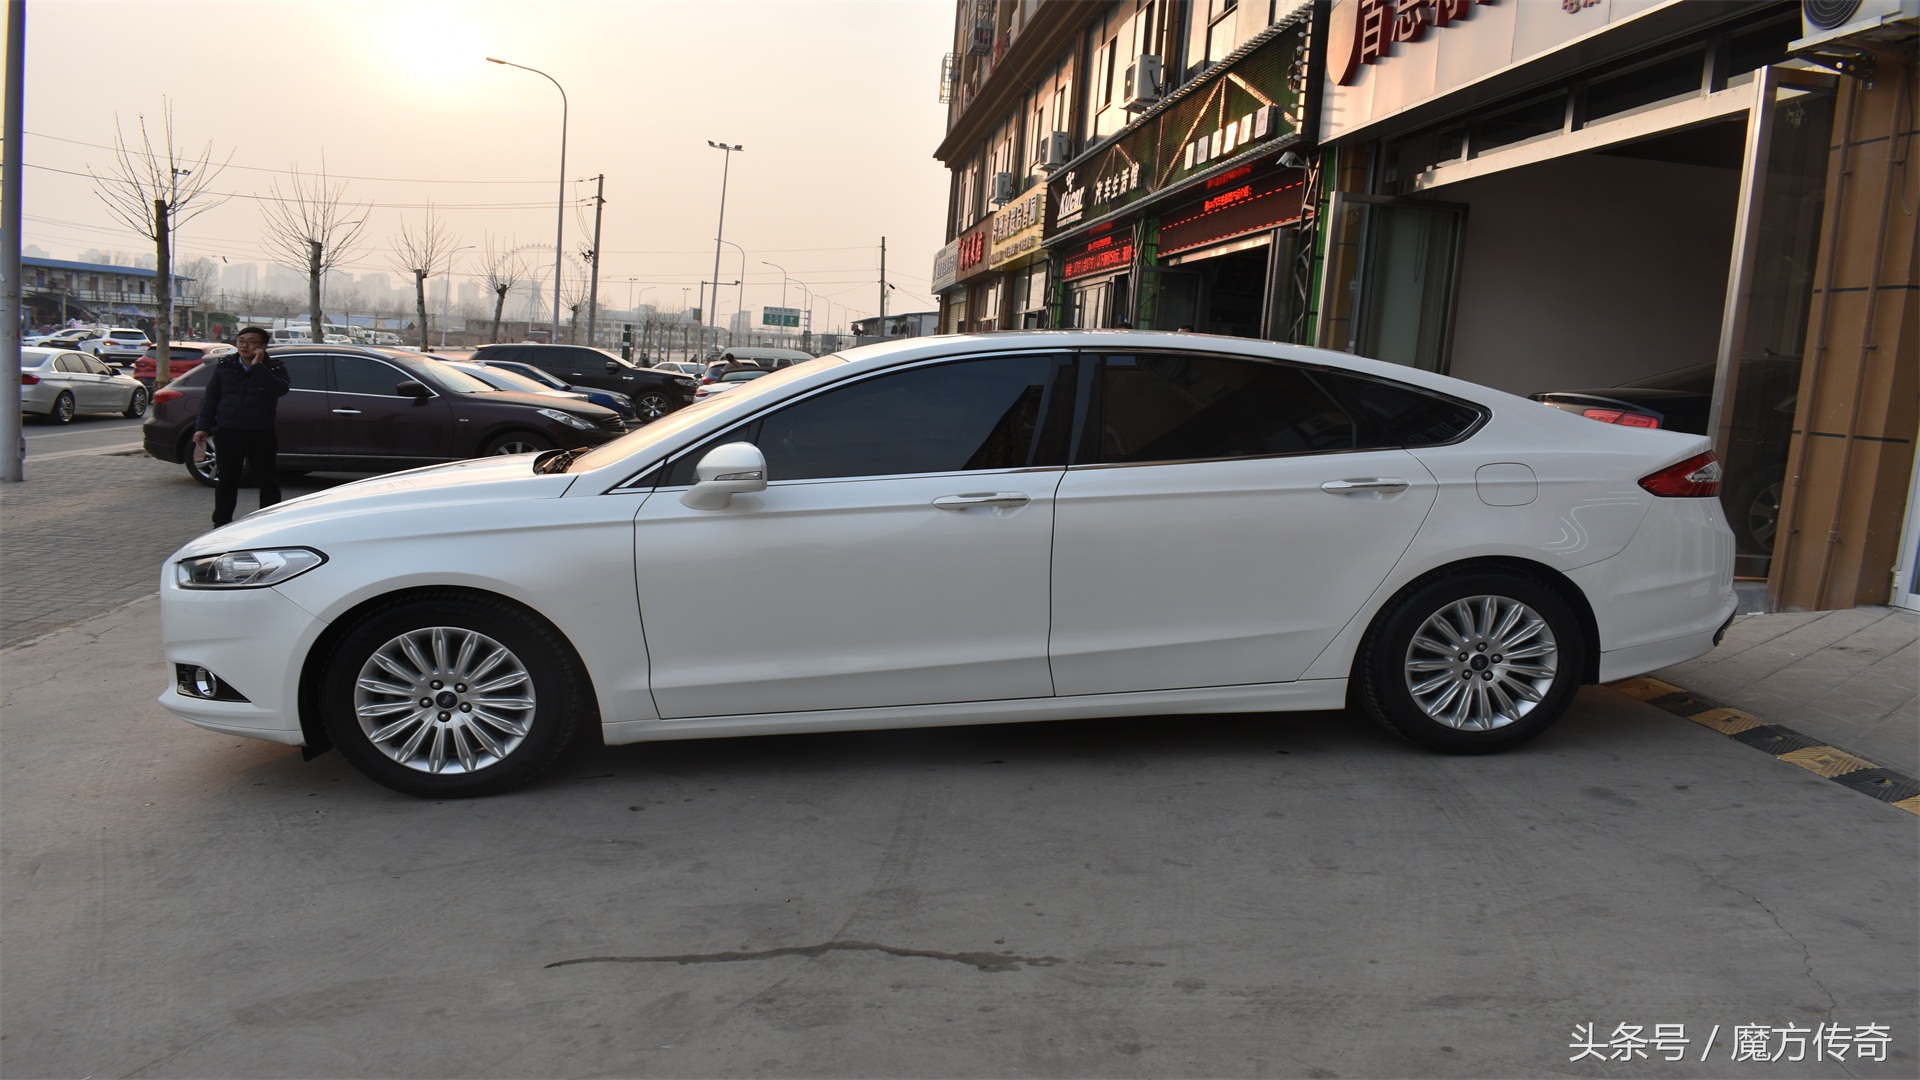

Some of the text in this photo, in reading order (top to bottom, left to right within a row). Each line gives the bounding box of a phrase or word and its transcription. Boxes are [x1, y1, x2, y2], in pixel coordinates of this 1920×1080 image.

[1094, 161, 1140, 206] 汽车生活馆
